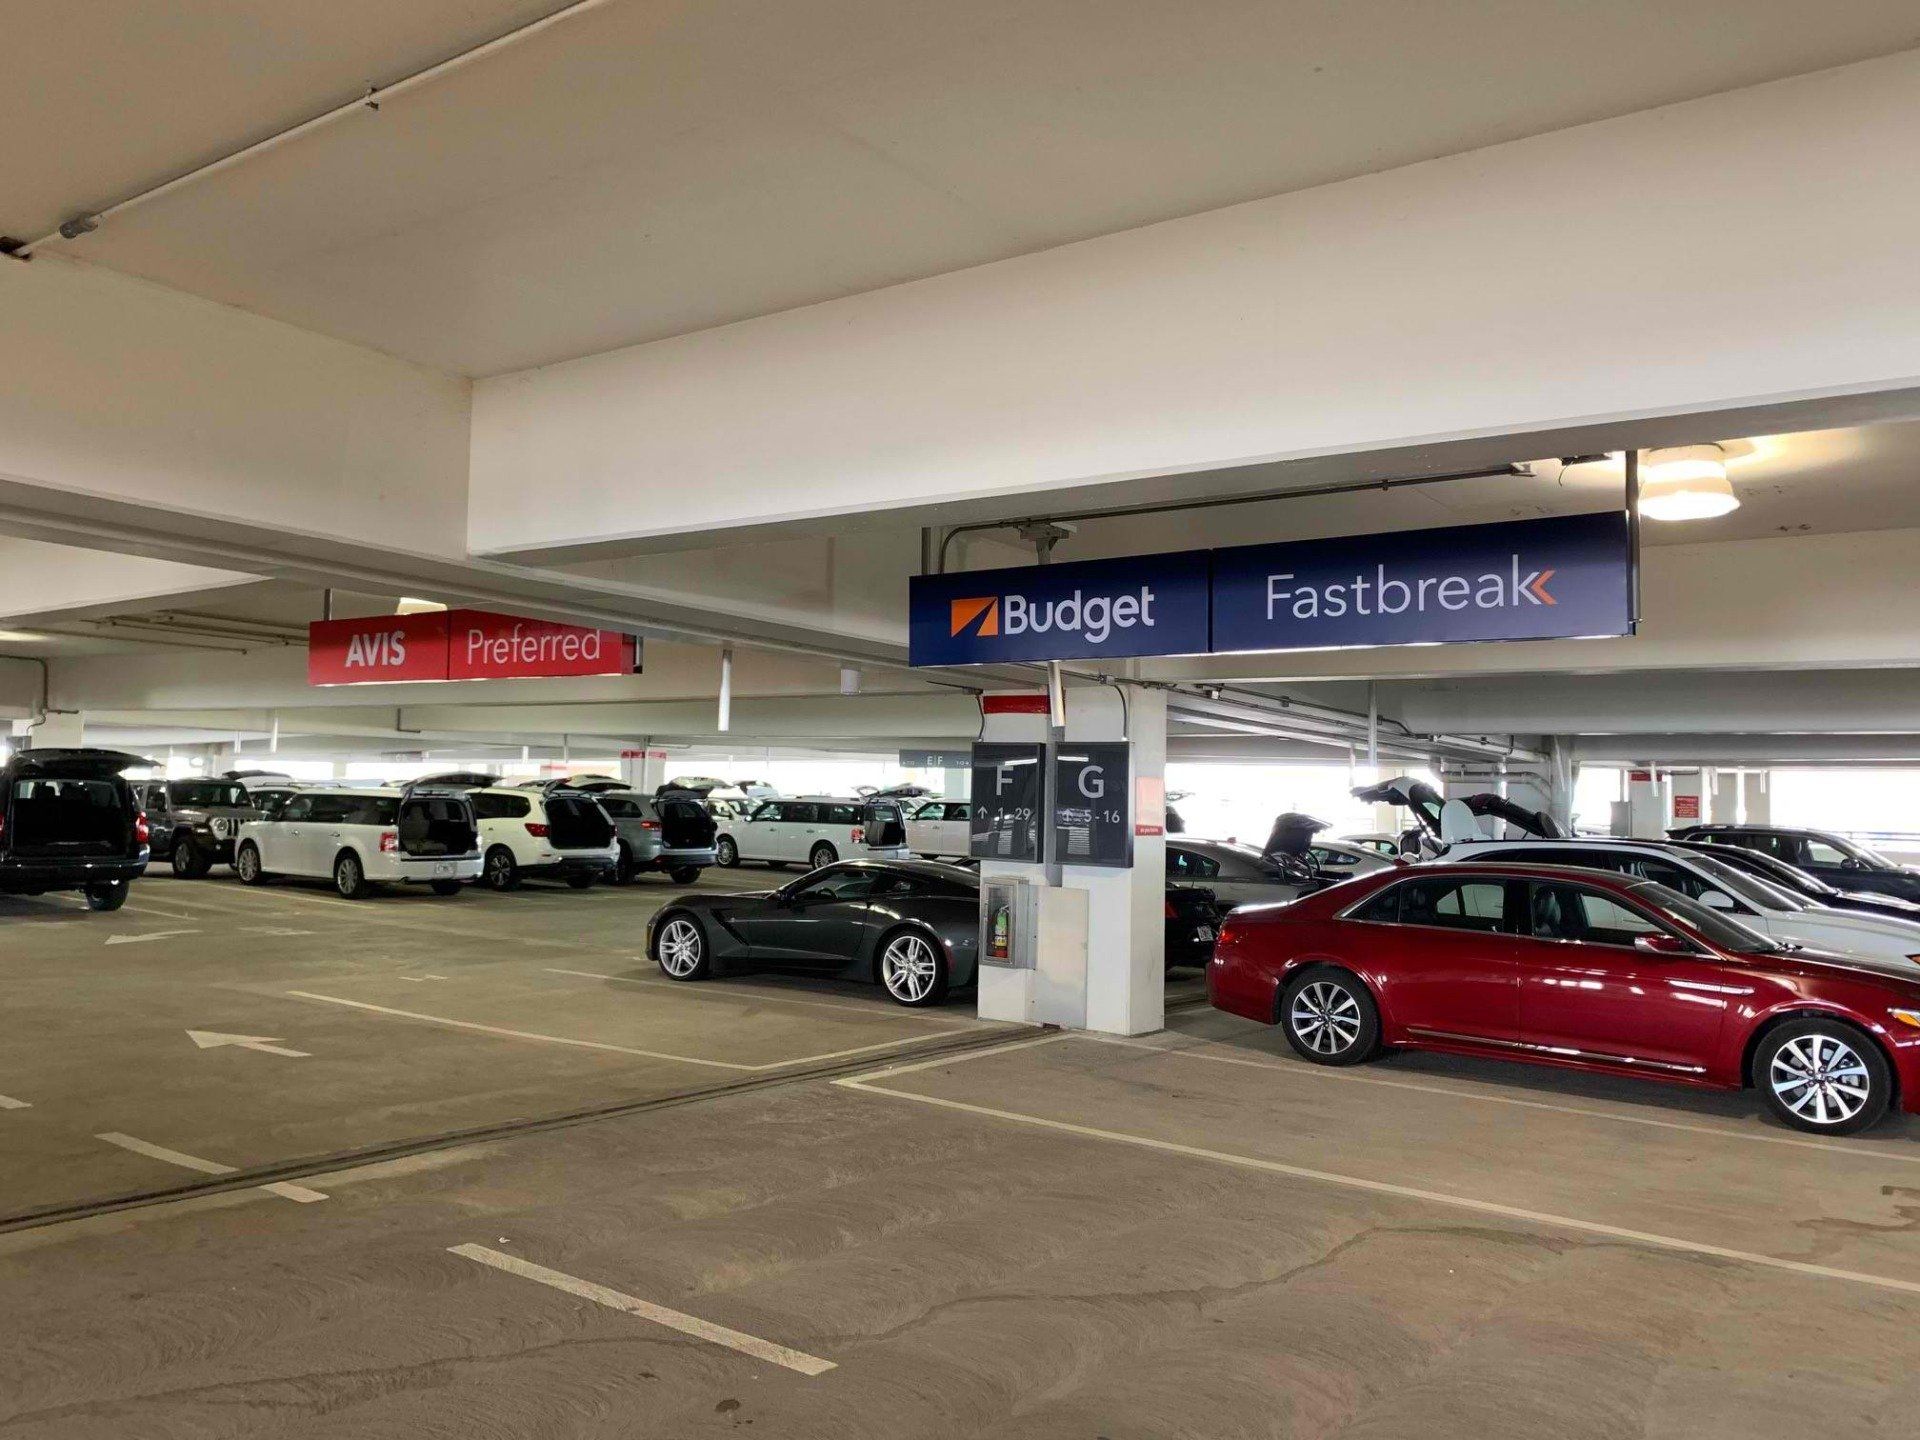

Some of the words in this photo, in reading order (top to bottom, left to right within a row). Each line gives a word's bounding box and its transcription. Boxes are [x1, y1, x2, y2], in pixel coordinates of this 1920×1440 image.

[1266, 554, 1541, 620] Fastbreak
[1004, 586, 1155, 644] Budget
[345, 630, 405, 667] AVIS
[467, 623, 601, 665] Preferred
[996, 765, 1014, 796] F
[1078, 765, 1105, 799] G
[1103, 810, 1120, 824] 16
